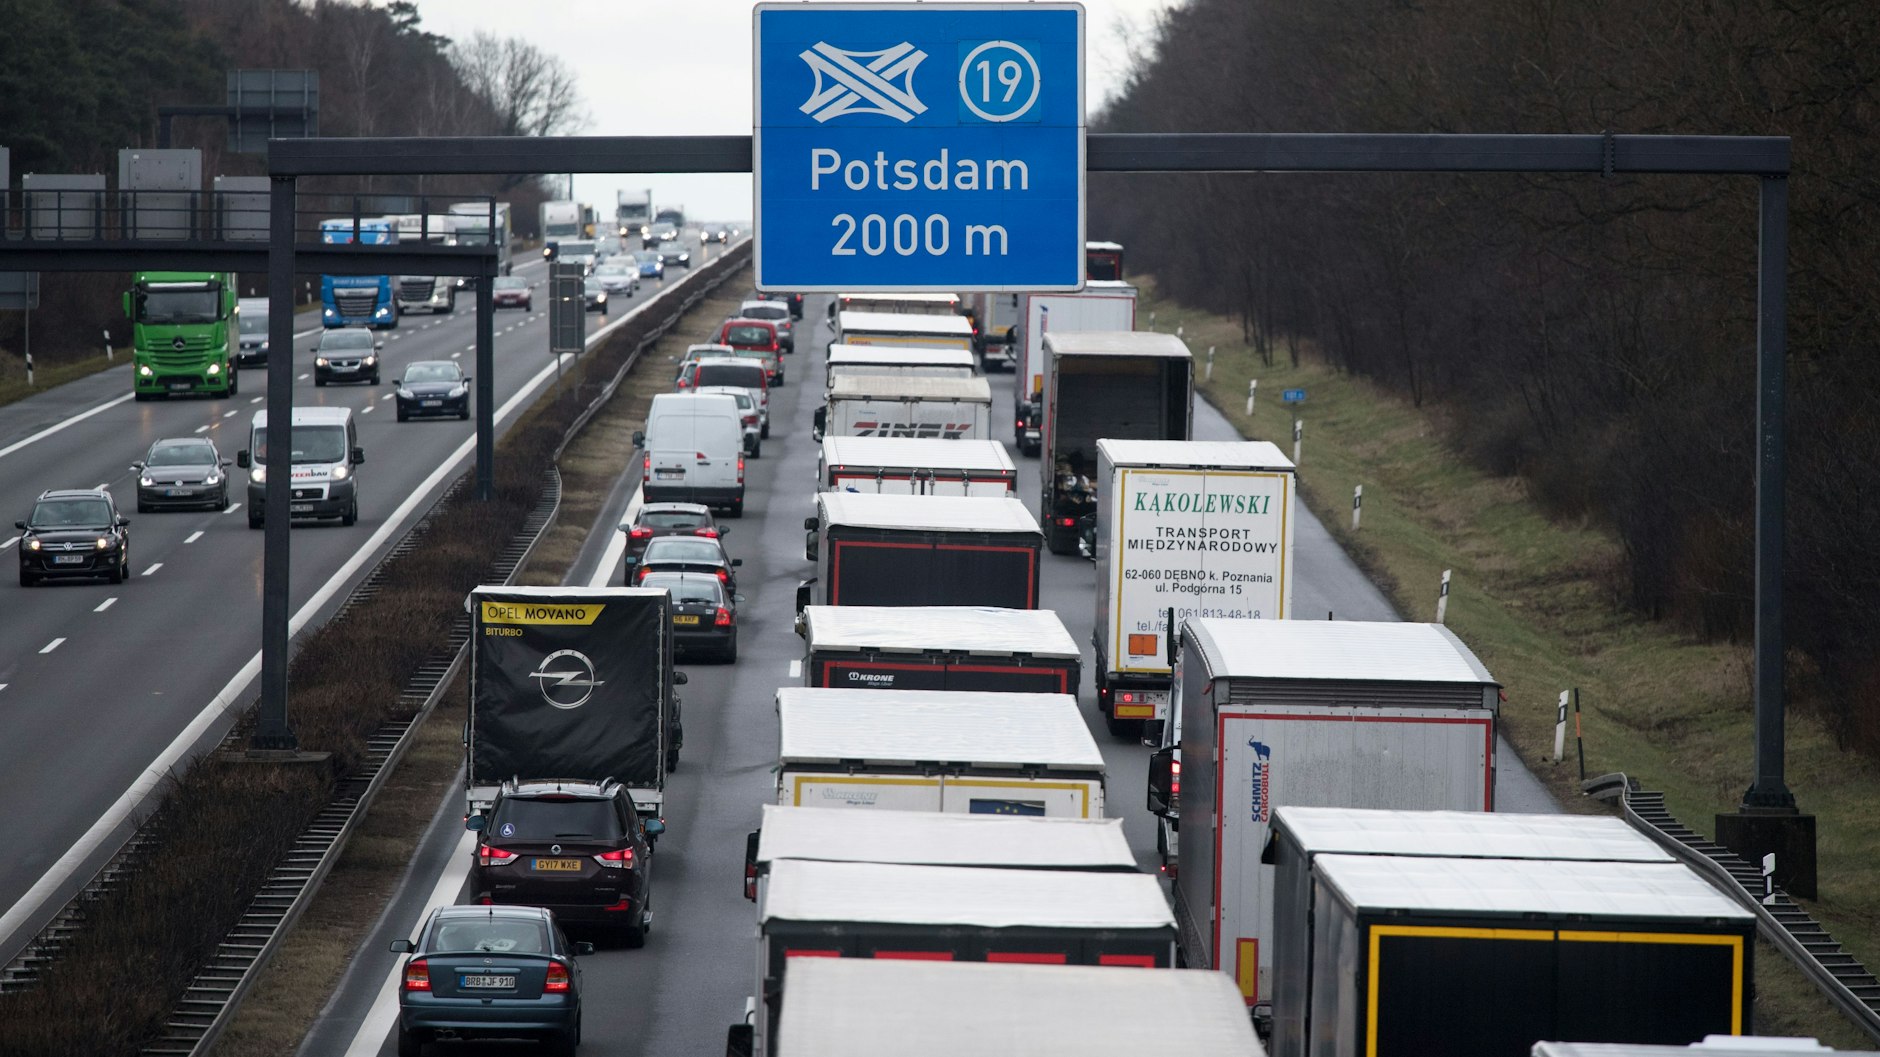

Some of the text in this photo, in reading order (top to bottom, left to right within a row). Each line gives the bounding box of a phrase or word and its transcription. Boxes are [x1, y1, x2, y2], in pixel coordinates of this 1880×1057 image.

[976, 60, 1023, 103] 19
[811, 148, 1029, 191] Potsdam
[831, 213, 1008, 256] 2000 m
[1134, 492, 1271, 517] KĄKOLEWSKI
[1155, 527, 1251, 540] TRANSPORT
[1127, 539, 1278, 554] MIĘDZYNARODOWY
[1125, 569, 1273, 583] 62-060 DĘBNO k. Poznania
[1155, 583, 1242, 595] ul. Podgórna 15
[487, 606, 586, 620] OPEL MOVANO
[1178, 608, 1198, 619] 061
[485, 627, 523, 637] BITURBO
[1137, 621, 1169, 632] tel./fa
[860, 674, 895, 682] KRONE
[1252, 762, 1262, 822] SCHMITZ
[1261, 762, 1269, 822] CARGOBULL
[539, 860, 578, 869] GY17 WXE
[465, 976, 514, 987] BRB JF 910
